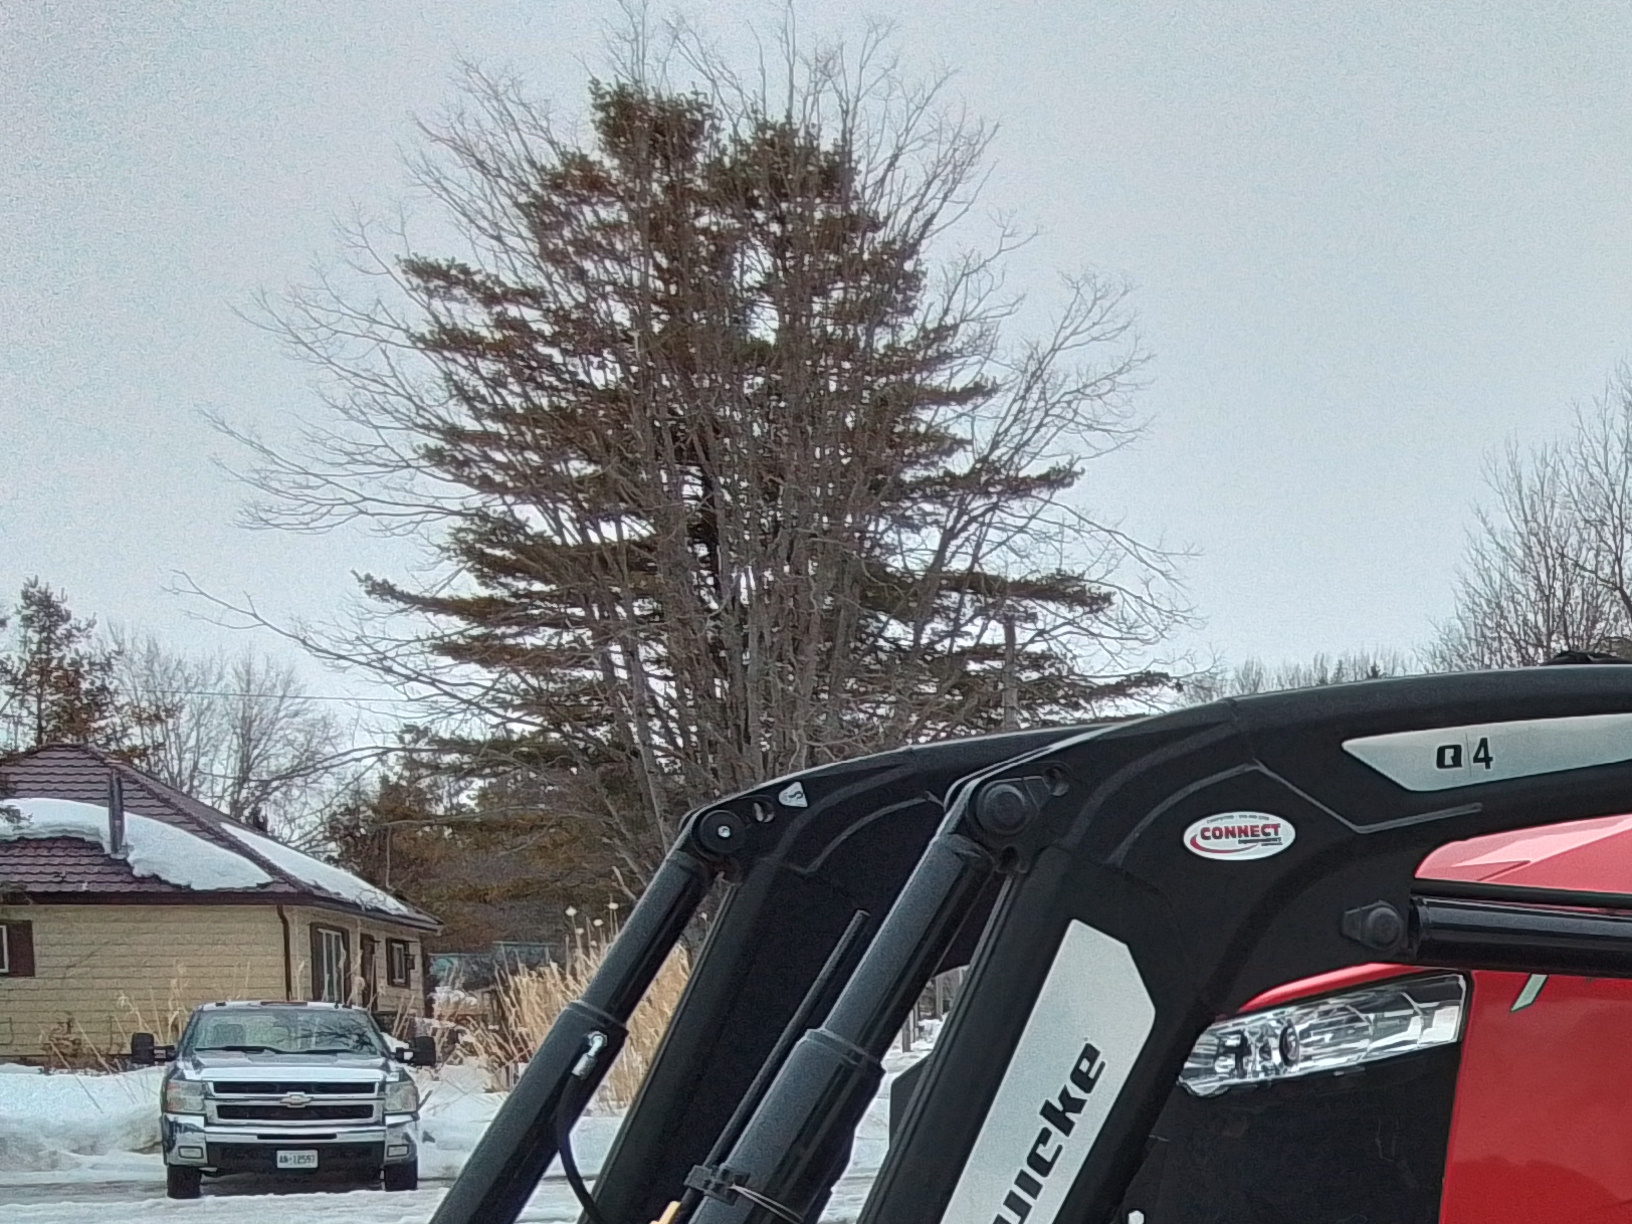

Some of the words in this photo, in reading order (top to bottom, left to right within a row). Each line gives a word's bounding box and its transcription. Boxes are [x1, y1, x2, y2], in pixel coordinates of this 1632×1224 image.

[1436, 744, 1463, 769] Q
[1473, 737, 1494, 770] 4
[1200, 823, 1281, 840] CONNECT
